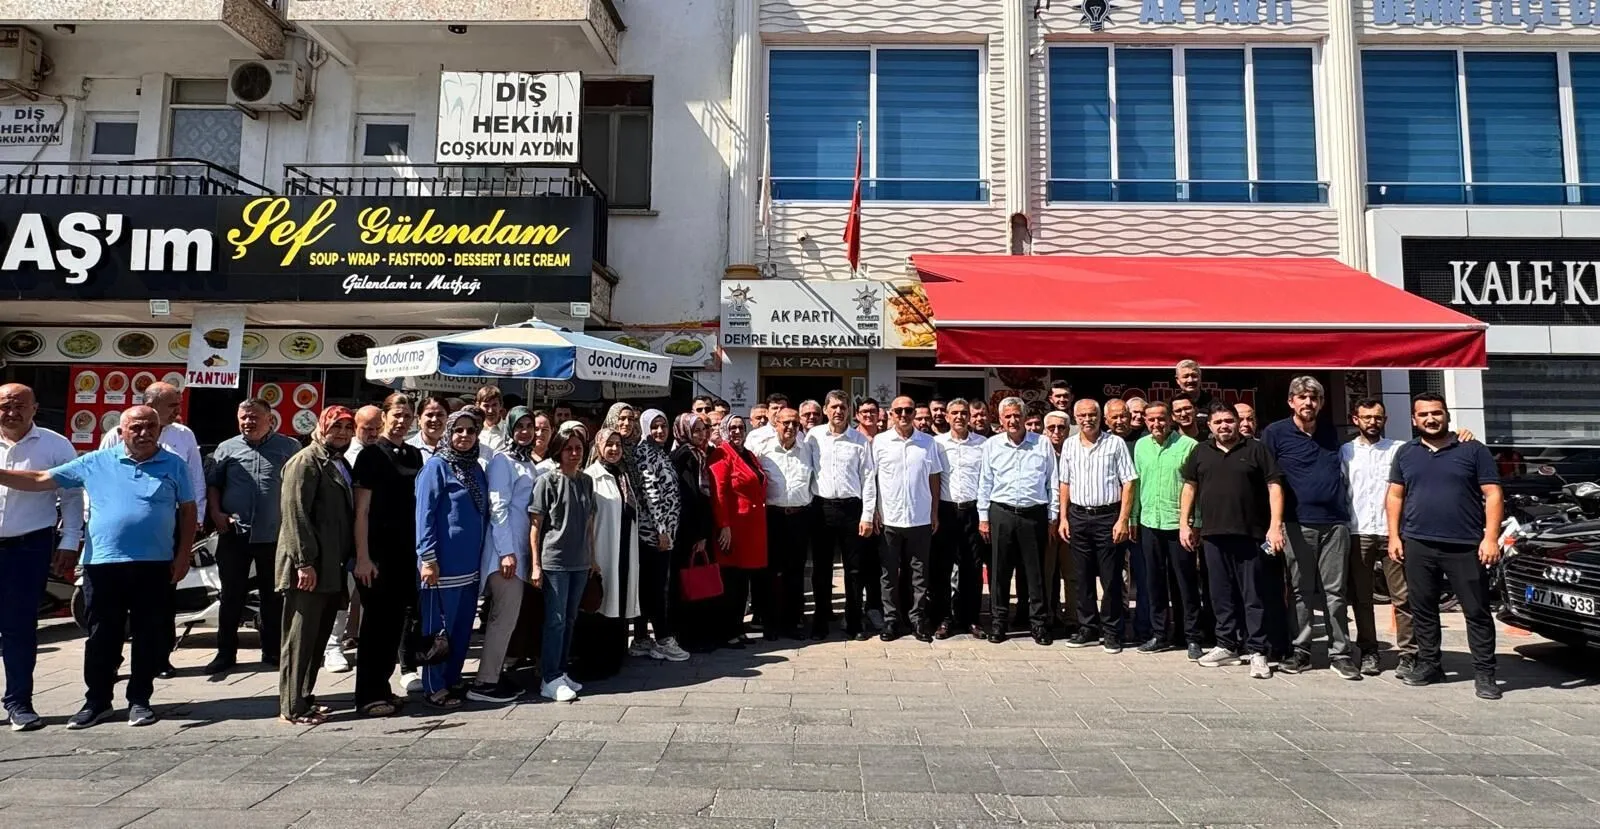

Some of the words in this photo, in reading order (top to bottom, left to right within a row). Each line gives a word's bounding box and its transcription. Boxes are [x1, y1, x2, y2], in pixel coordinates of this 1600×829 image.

[1139, 0, 1186, 24] AK
[1374, 0, 1482, 25] DEMRE
[496, 77, 547, 108] DİŞ
[15, 107, 45, 121] DİŞ
[472, 111, 573, 133] HEKİMİ
[440, 141, 514, 160] COŞKUN
[519, 141, 573, 156] AYDIN
[227, 197, 337, 267] Şef
[357, 206, 571, 245] Gülendam
[309, 252, 339, 267] SOUP
[347, 252, 381, 267] WRAP
[388, 252, 446, 267] FASTFOOD
[453, 252, 502, 267] DESSERT
[503, 253, 511, 267] &
[513, 253, 531, 267] ICE
[532, 253, 571, 268] CREAM
[1448, 260, 1557, 305] KALE
[771, 310, 790, 322] AK
[724, 333, 768, 345] DEMRE
[771, 331, 800, 348] İLÇE
[802, 332, 882, 348] BAŞKANLIĞI
[373, 347, 425, 366] dondurma
[483, 354, 532, 367] karpedo
[588, 350, 658, 373] dondurma
[770, 357, 793, 368] AK
[1533, 589, 1546, 603] 07
[1550, 592, 1564, 608] AK
[1569, 596, 1593, 613] 933
